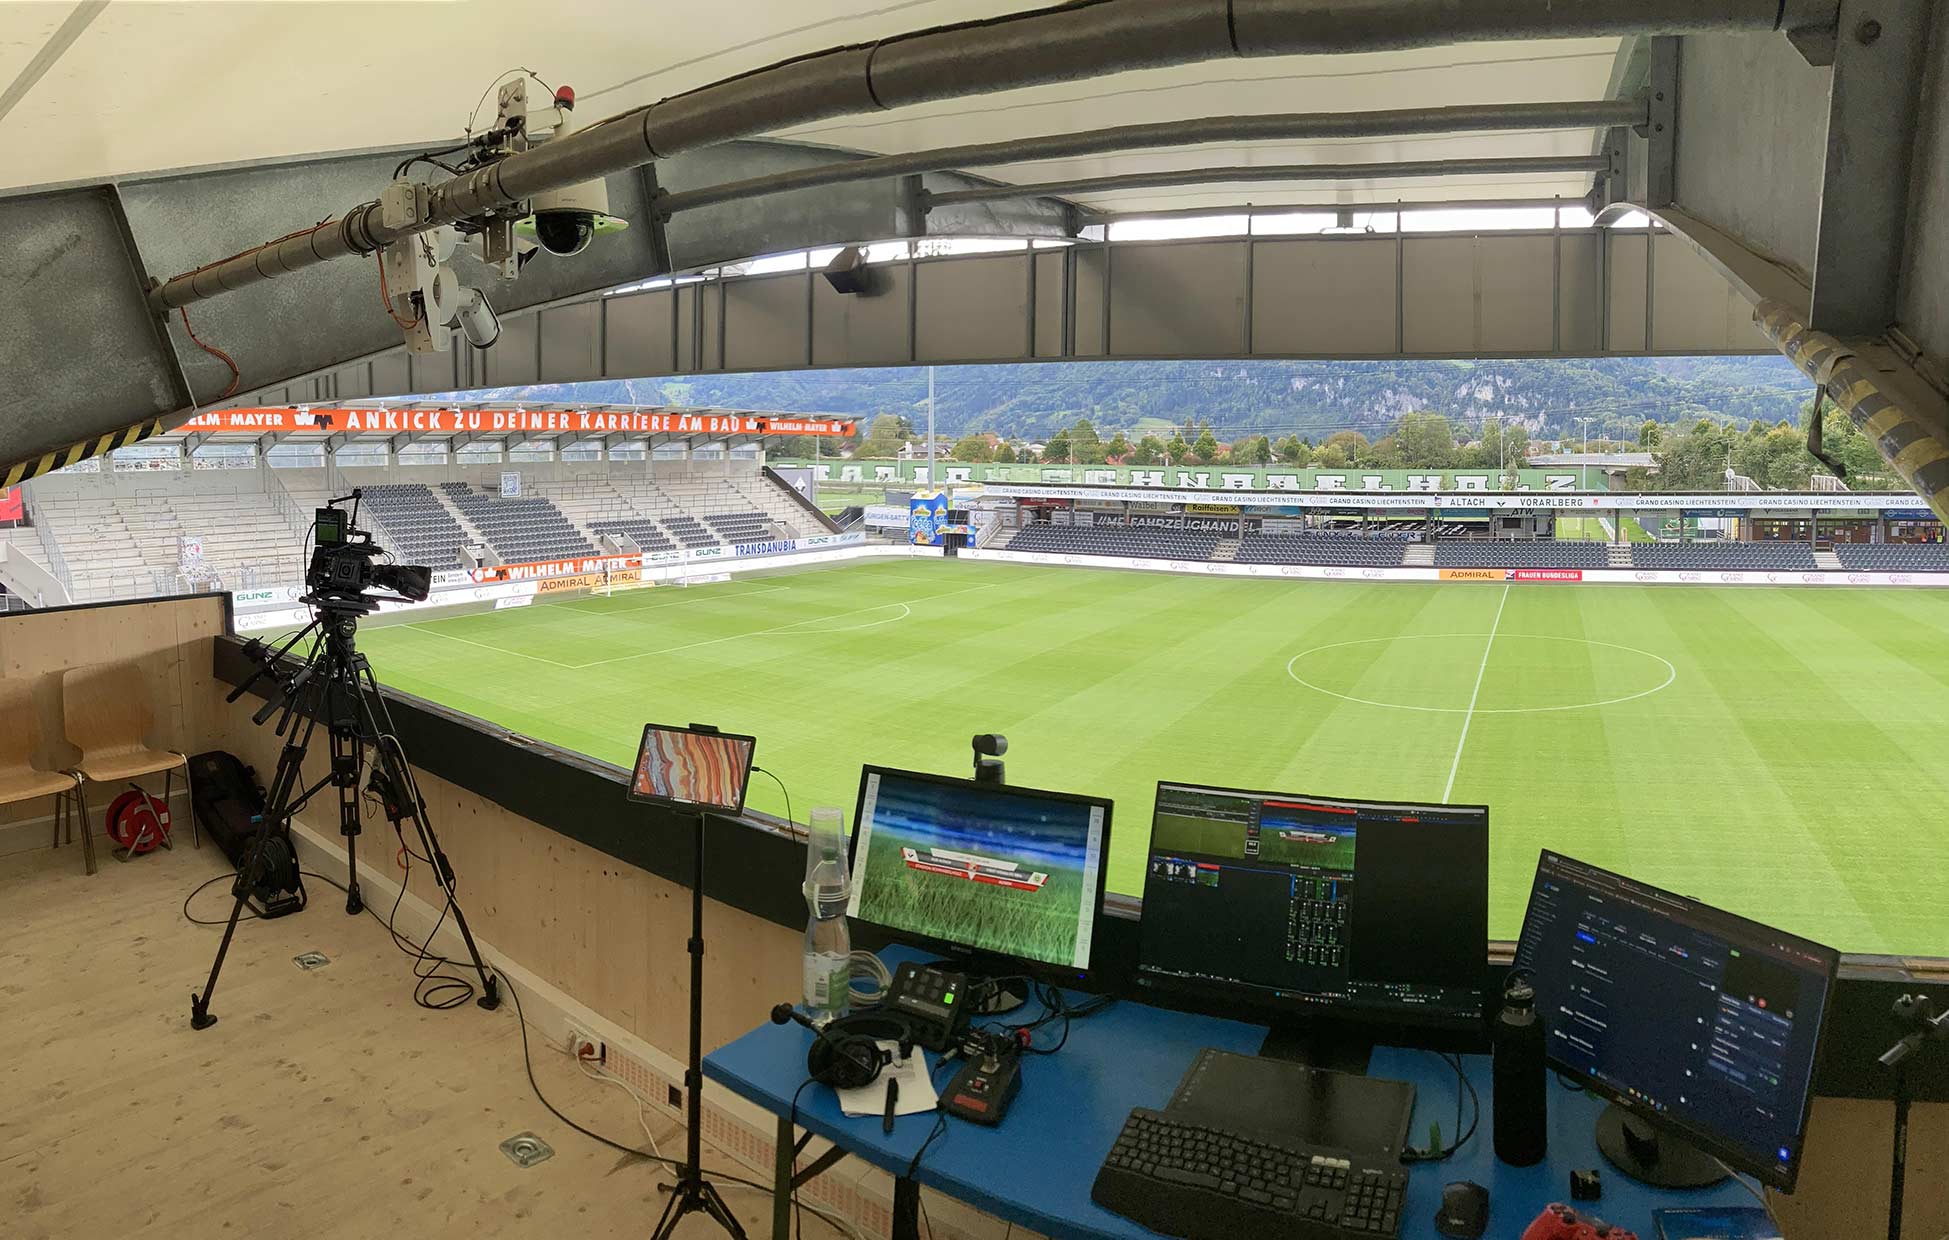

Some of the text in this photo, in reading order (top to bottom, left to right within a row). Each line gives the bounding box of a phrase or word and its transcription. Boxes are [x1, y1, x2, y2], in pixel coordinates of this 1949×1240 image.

[230, 413, 284, 426] MAYER
[346, 411, 441, 429] ANKICK
[453, 412, 481, 429] ZU
[493, 412, 569, 429] DEINER
[580, 413, 670, 430] KARRIERE
[678, 416, 702, 431] AM
[710, 417, 740, 432] BAU
[769, 422, 803, 431] WILHELM
[804, 423, 828, 432] MAYER
[1257, 496, 1304, 504] LIECHTENSTEIN
[1352, 497, 1376, 505] CASINO
[1450, 498, 1485, 507] ALTACH
[1520, 498, 1584, 507] VORARLBERG
[1192, 503, 1229, 512] Raiffeisen
[431, 574, 446, 584] EIN
[508, 562, 574, 580] WILHELM
[582, 557, 626, 573] MAER
[695, 548, 721, 557] GUNZ
[735, 539, 797, 557] TRANSDANUBIA
[1450, 570, 1579, 580] ADMIRAL FRAUEN BUNDESLIGA
[540, 576, 590, 592] ADMIRAL
[236, 591, 273, 601] GUNZ
